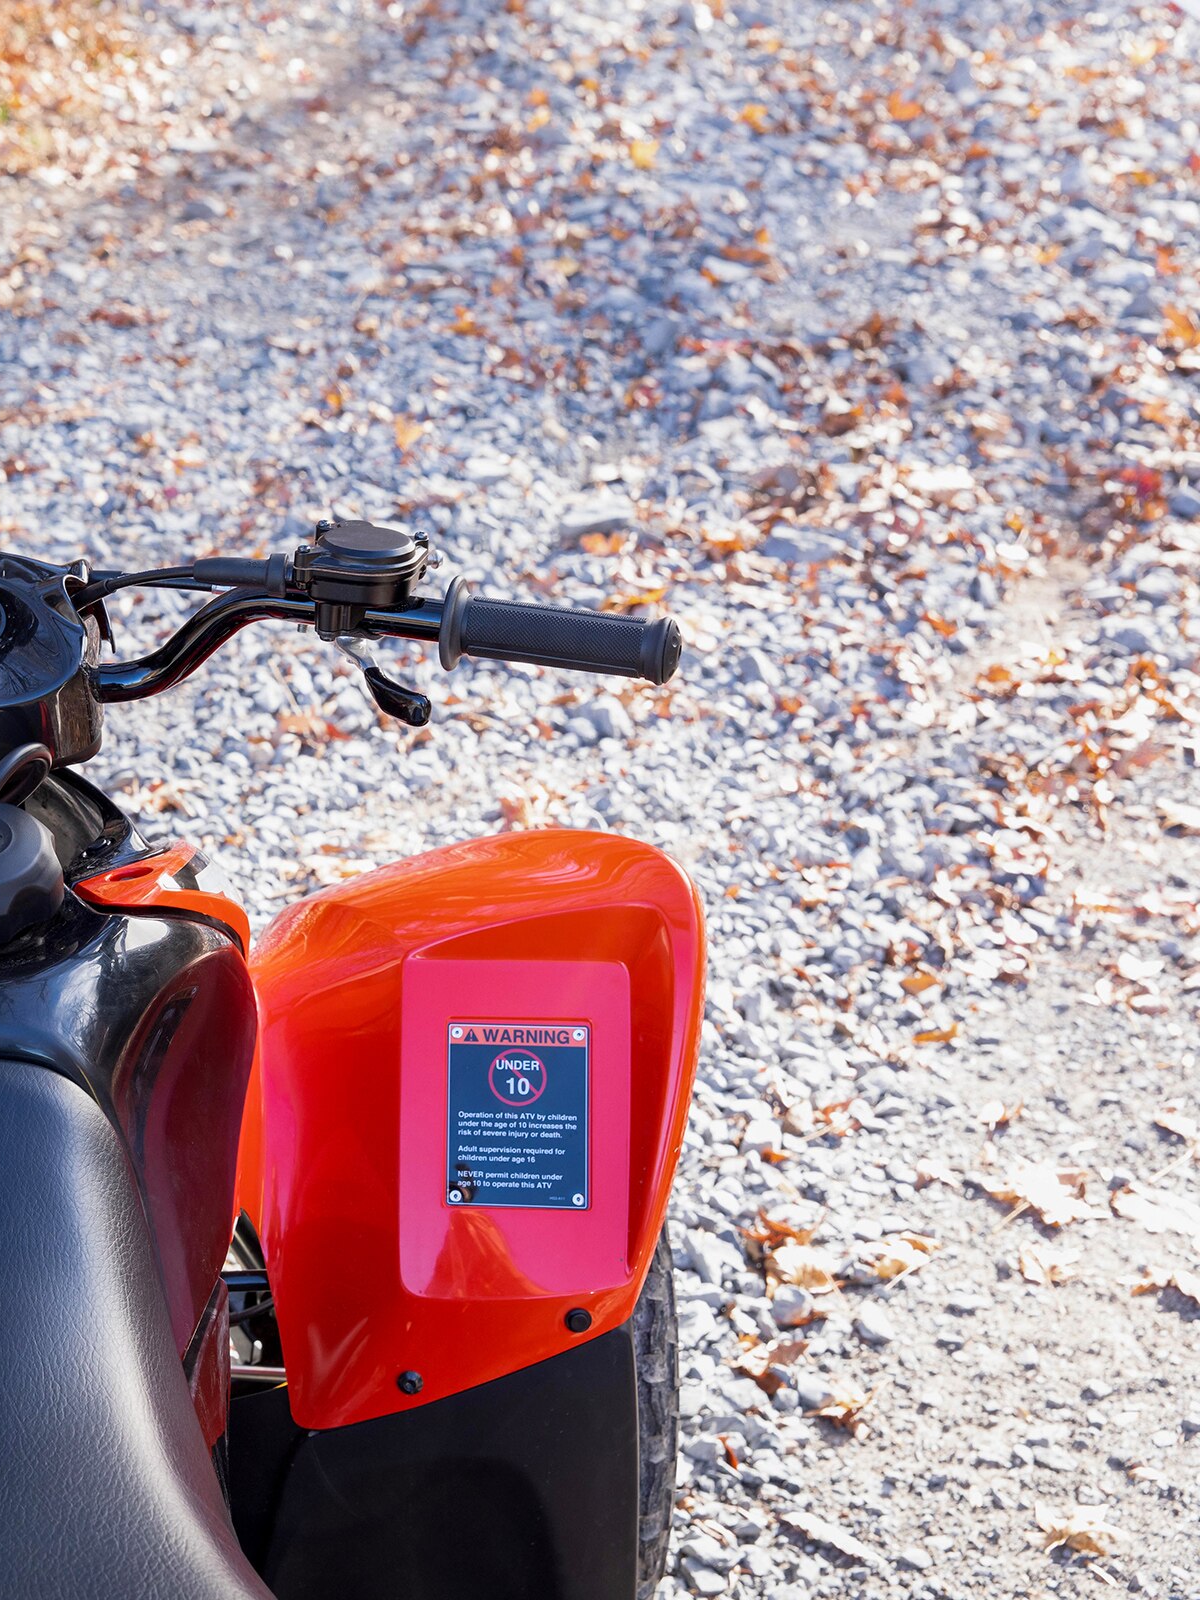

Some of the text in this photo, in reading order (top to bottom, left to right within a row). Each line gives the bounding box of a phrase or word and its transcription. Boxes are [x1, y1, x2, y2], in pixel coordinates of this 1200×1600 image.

[483, 1029, 570, 1044] WARNING
[496, 1060, 540, 1070] UNDER
[506, 1078, 530, 1095] 10
[458, 1111, 493, 1120] Operation
[537, 1113, 545, 1121] by
[508, 1131, 528, 1139] injury
[486, 1172, 508, 1180] permit
